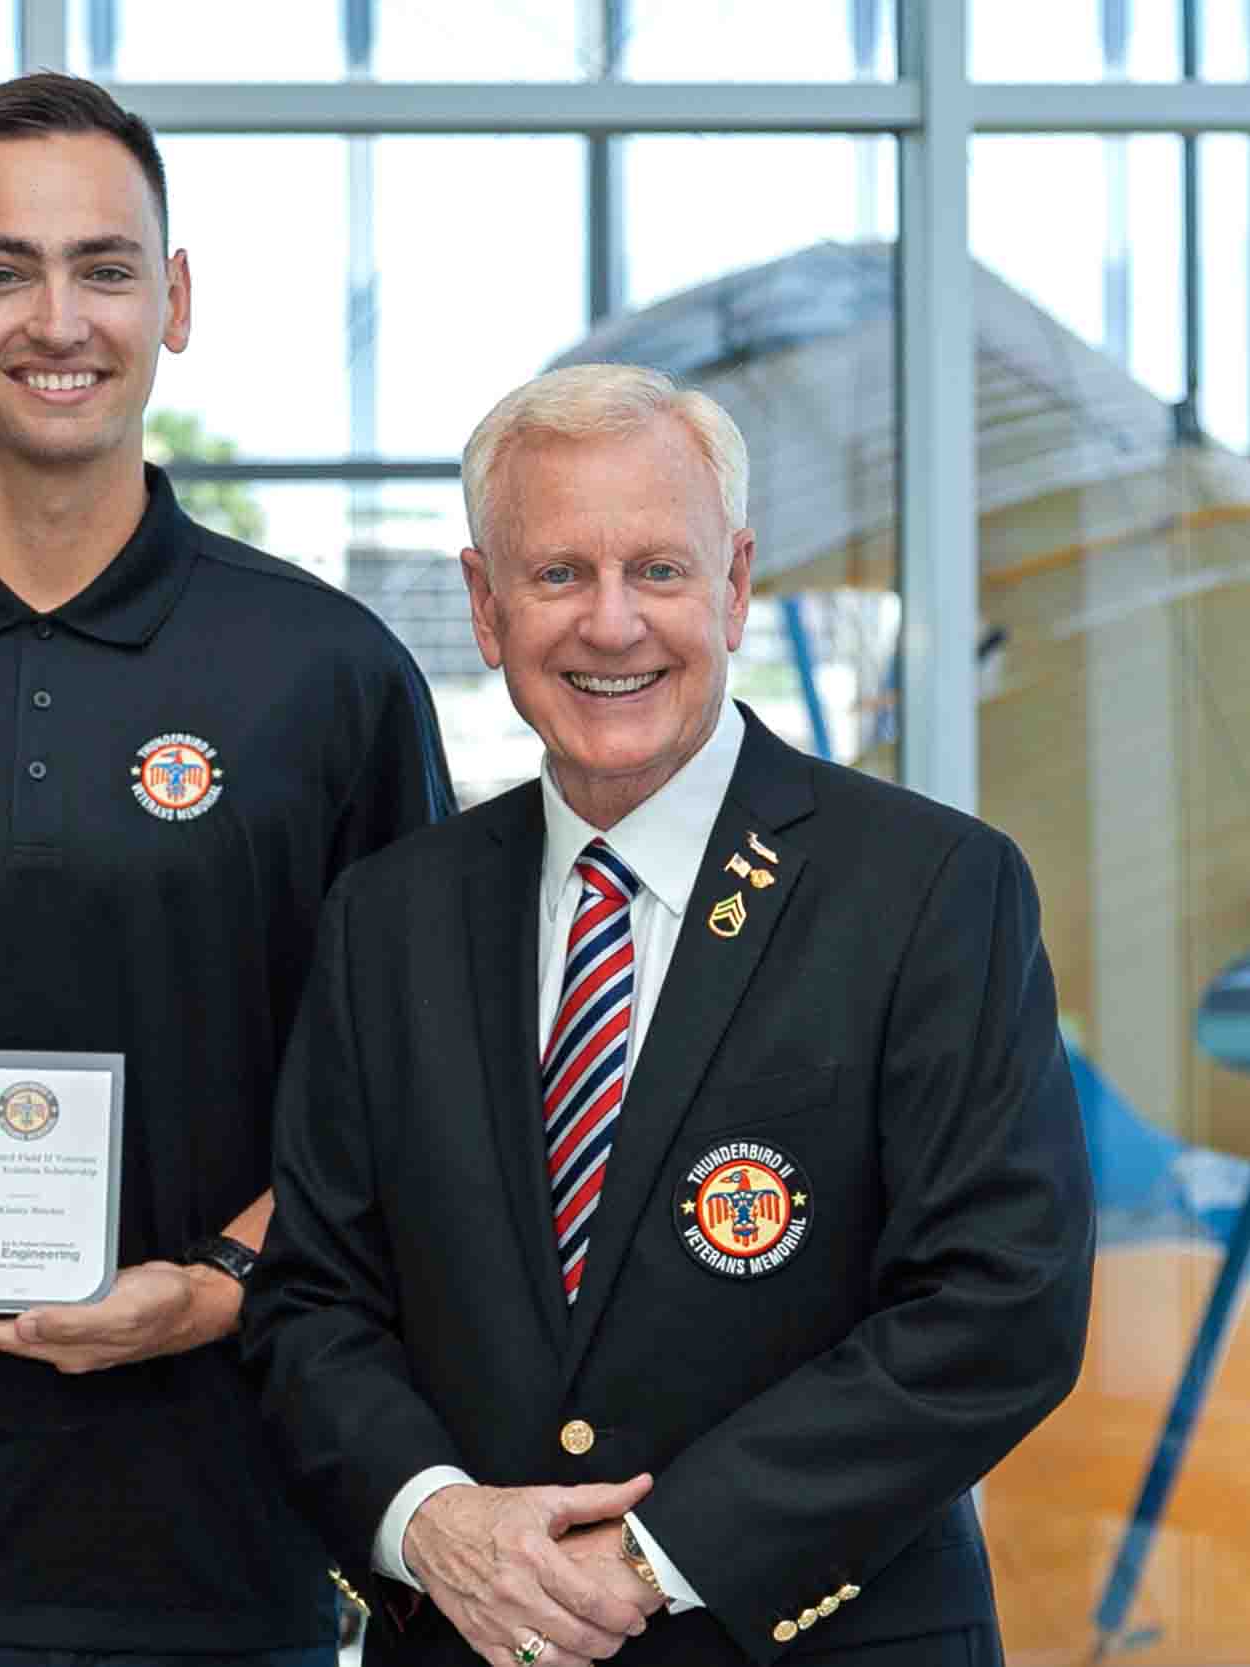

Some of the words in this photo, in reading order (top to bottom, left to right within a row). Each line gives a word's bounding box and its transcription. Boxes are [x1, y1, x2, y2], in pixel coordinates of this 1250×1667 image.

[135, 733, 209, 759] THUNDERBIRD
[131, 782, 175, 821] VETERANS
[176, 784, 223, 821] MEMORIAL
[687, 1142, 783, 1185] THUNDERBIRD
[779, 1163, 796, 1179] II
[1, 1247, 82, 1263] Engineering
[683, 1224, 746, 1275] VETERANS
[750, 1216, 807, 1275] MEMORIAL
